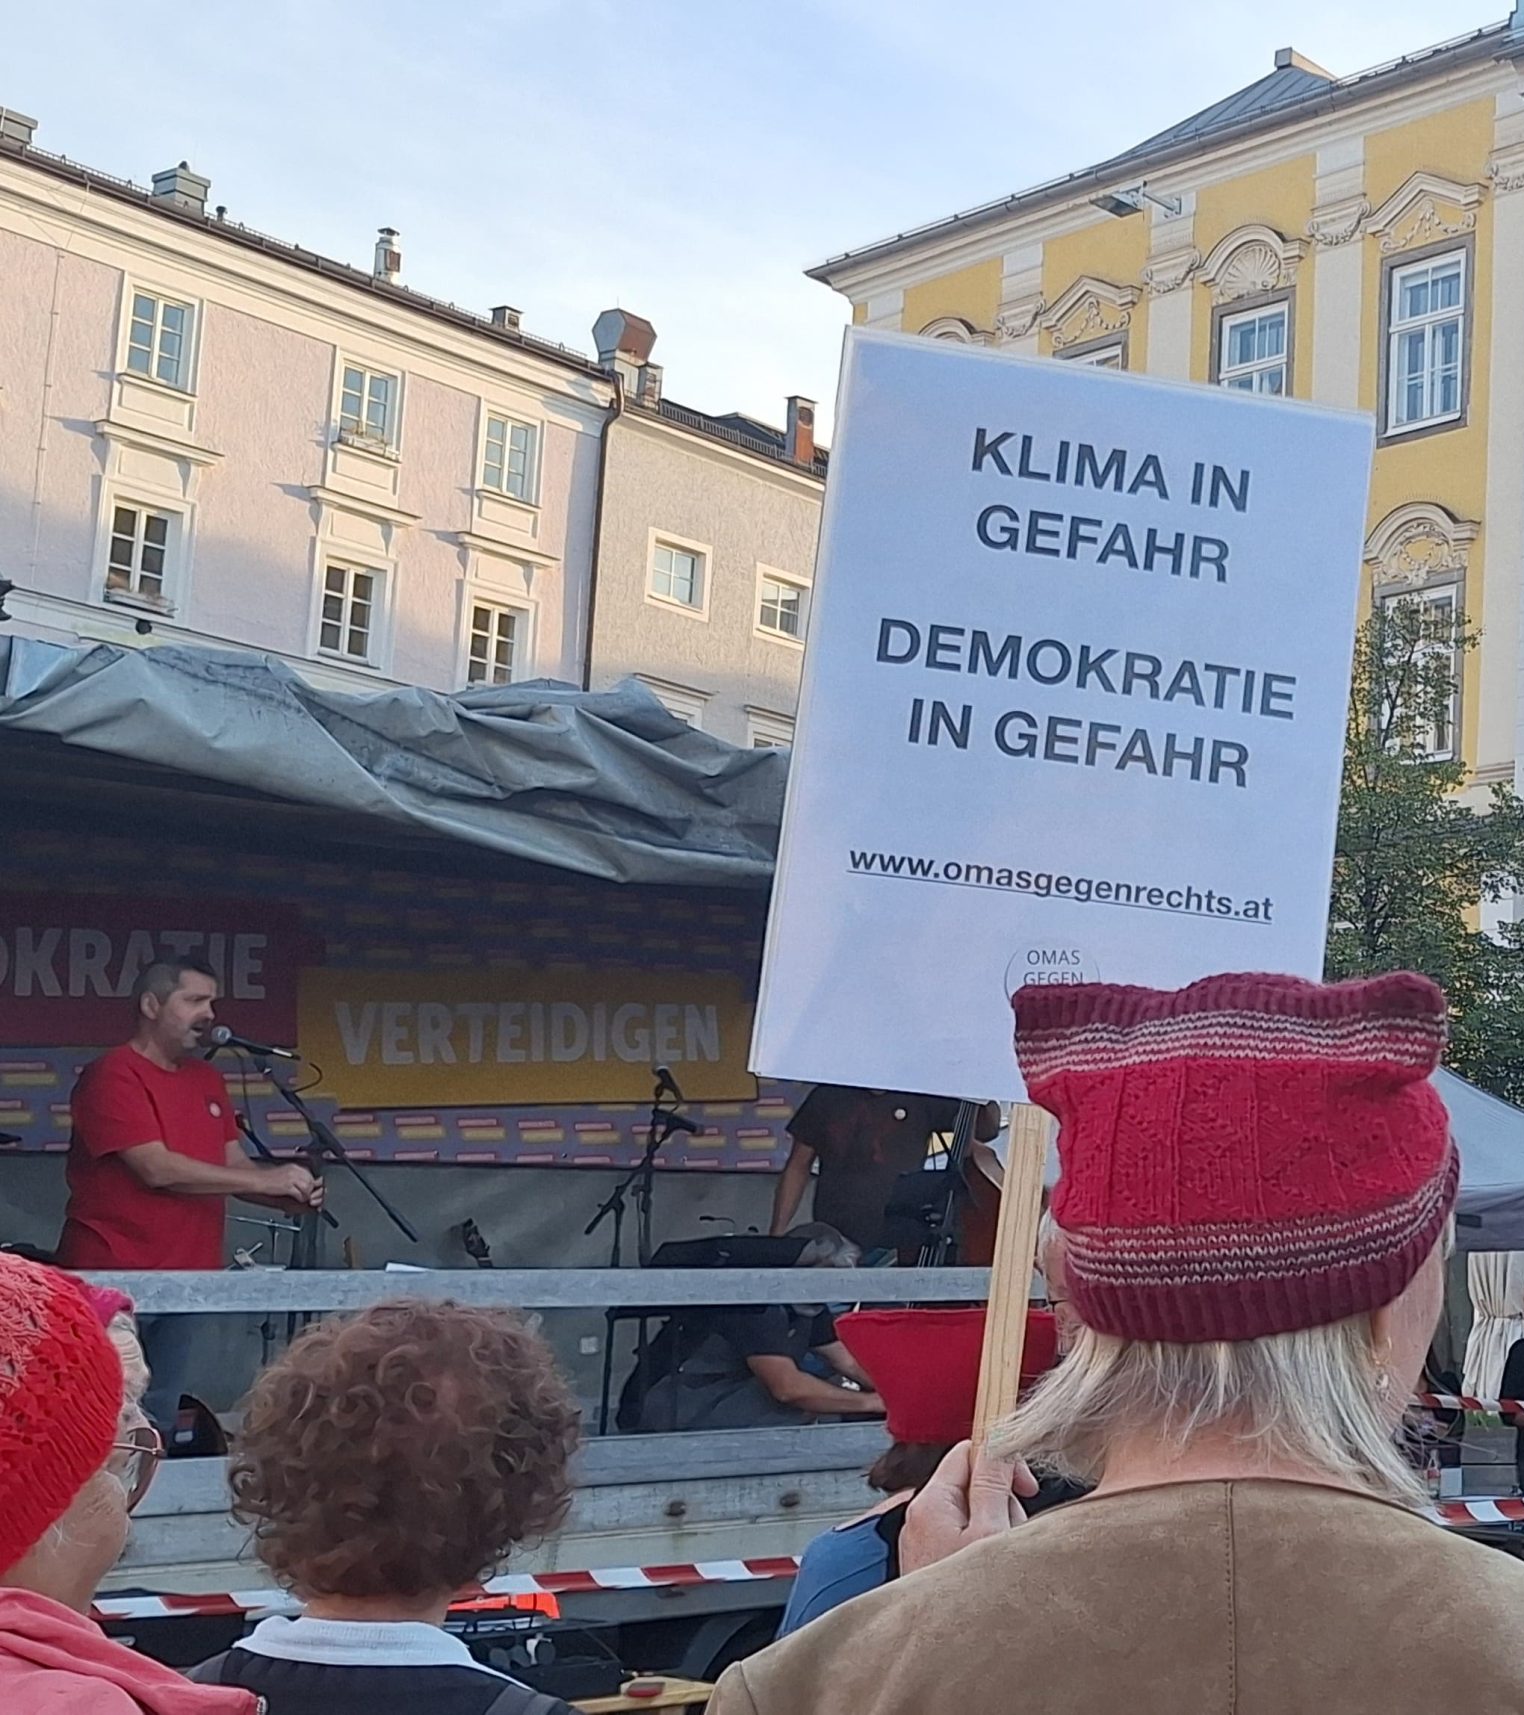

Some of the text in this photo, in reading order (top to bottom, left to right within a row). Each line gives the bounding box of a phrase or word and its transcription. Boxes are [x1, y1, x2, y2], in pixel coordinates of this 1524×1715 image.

[971, 427, 1251, 512] KLIMA IN
[976, 504, 1230, 583] GEFAHR
[876, 618, 1297, 720] DEMOKRATIE
[908, 698, 1249, 788] IN GEFAHR
[849, 849, 1274, 921] www.omasgegenrechts.at
[0, 927, 267, 999] KRATIE
[1026, 949, 1081, 965] OMAS
[335, 1001, 720, 1065] VERTEIDIGEN
